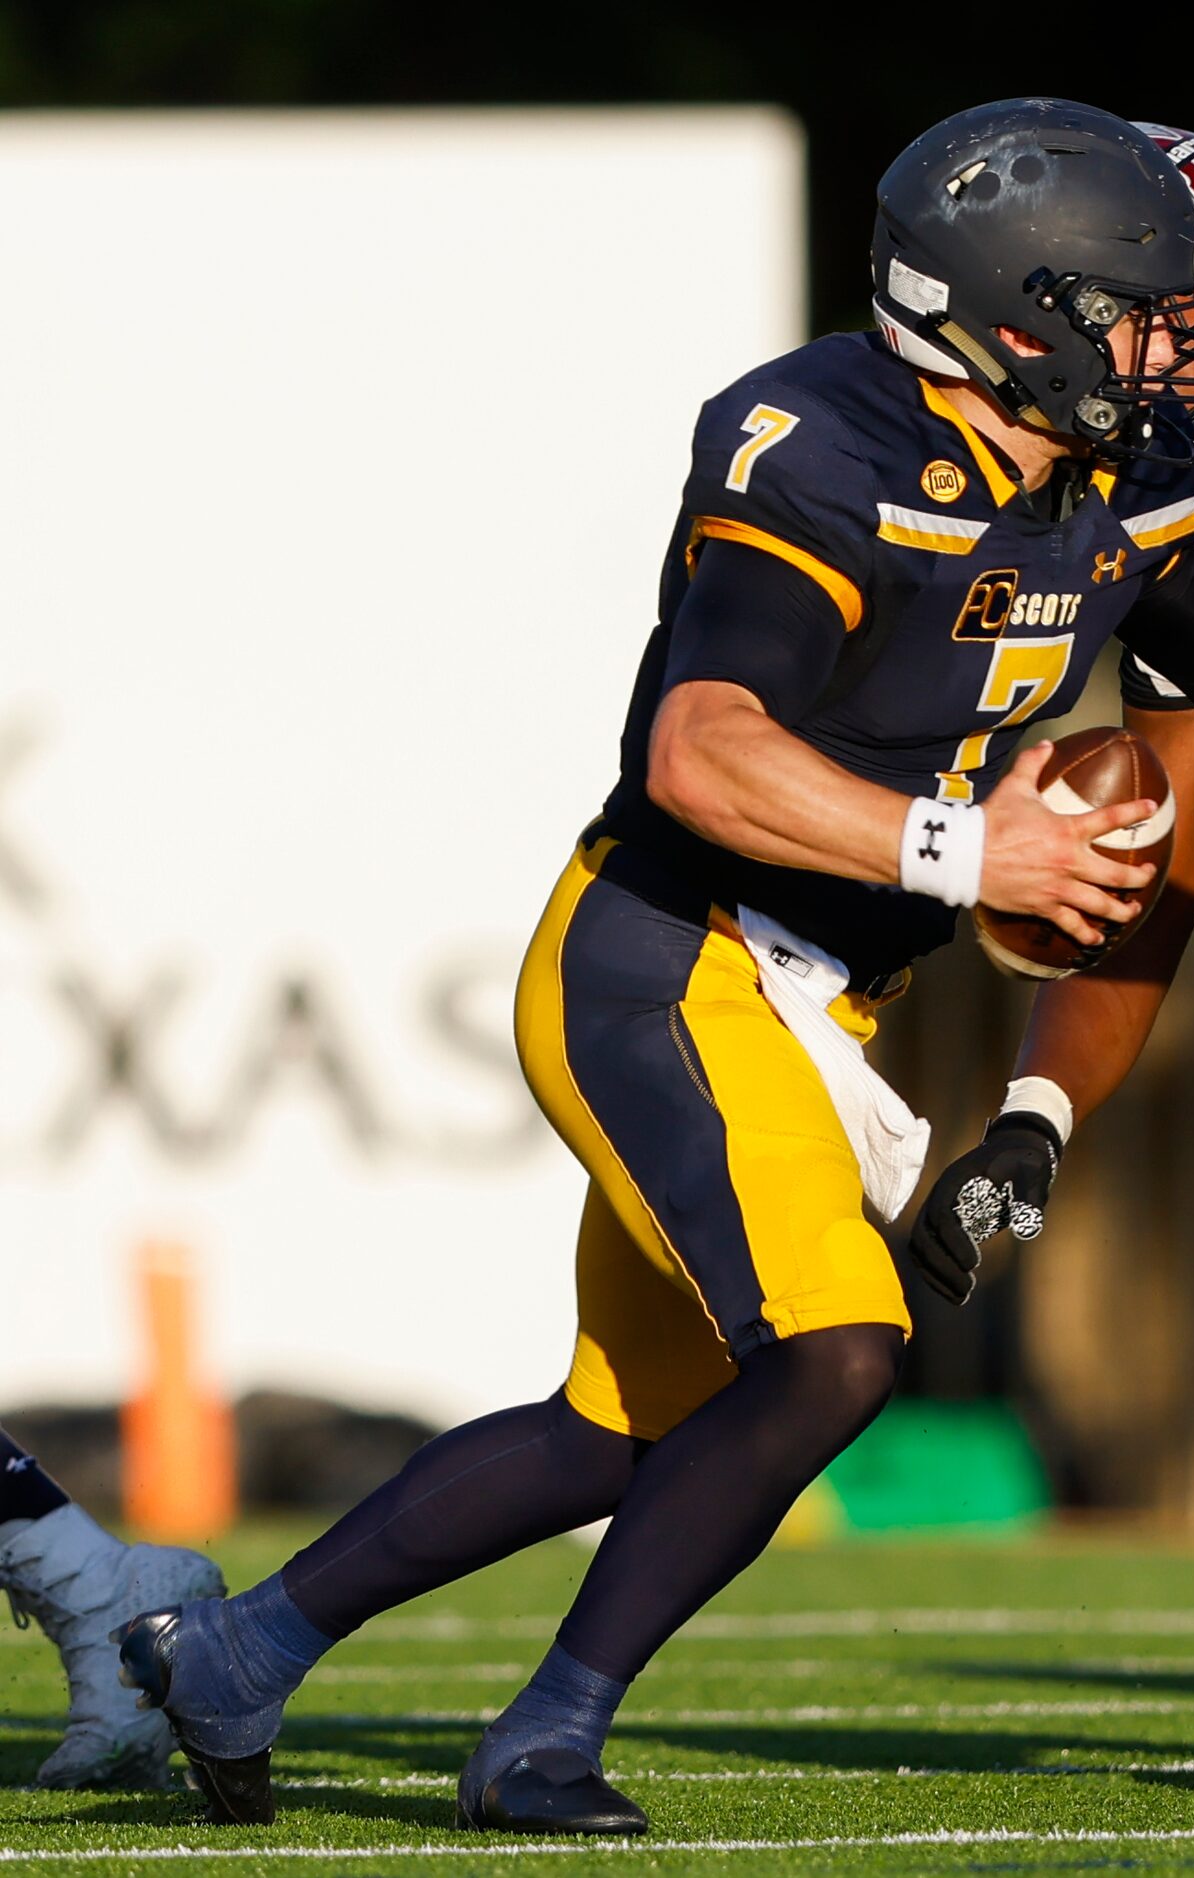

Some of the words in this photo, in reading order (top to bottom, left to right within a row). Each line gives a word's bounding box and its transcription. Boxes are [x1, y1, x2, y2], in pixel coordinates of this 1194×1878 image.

[725, 402, 801, 495] 7
[933, 473, 955, 490] 100
[1009, 592, 1083, 627] SCOTS
[934, 632, 1076, 806] 7
[0, 945, 556, 1178] XAS
